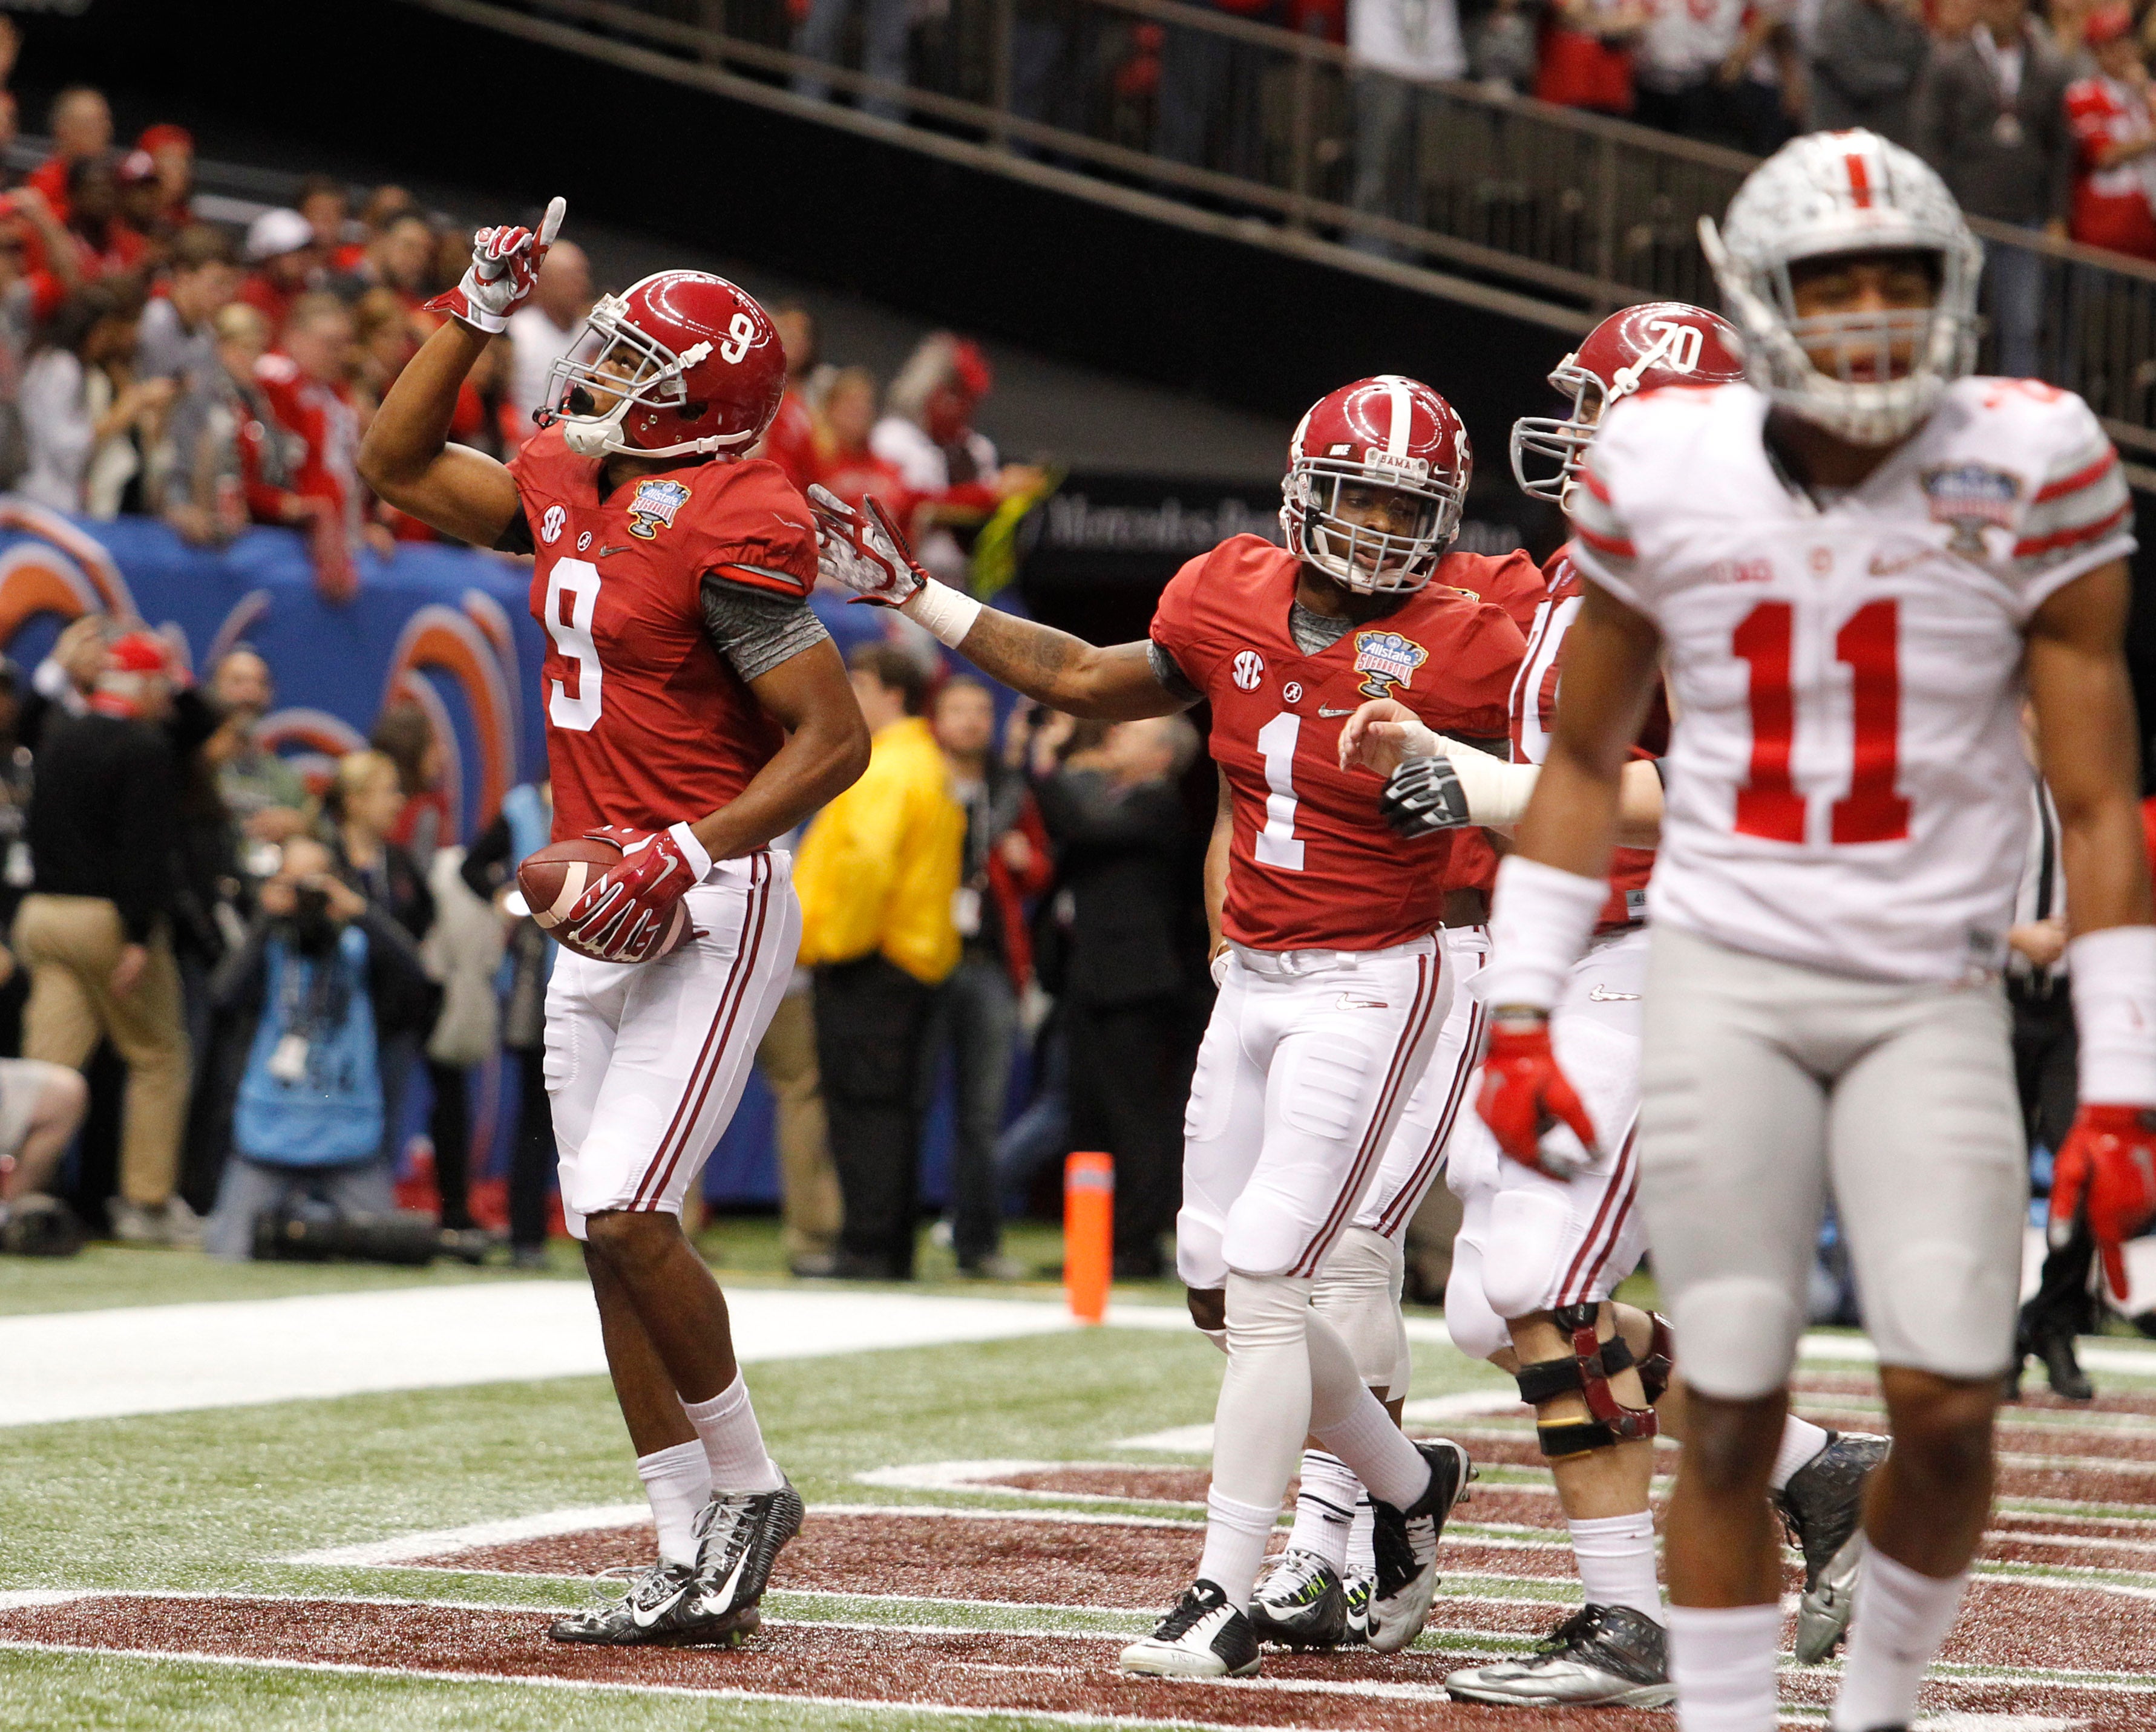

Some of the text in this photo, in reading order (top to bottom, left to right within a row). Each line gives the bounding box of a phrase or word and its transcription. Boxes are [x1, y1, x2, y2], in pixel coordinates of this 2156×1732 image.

[720, 313, 755, 364] 9
[1649, 320, 1705, 374] 70
[1380, 454, 1411, 469] BAMA
[643, 488, 680, 506] Allstate
[540, 505, 567, 543] SEC
[545, 557, 602, 732] 9
[1232, 650, 1264, 690] SEC
[1364, 642, 1412, 664] Allstate
[1731, 598, 1913, 845] 11
[1255, 712, 1305, 871] 1
[1405, 1514, 1437, 1566] NIKE
